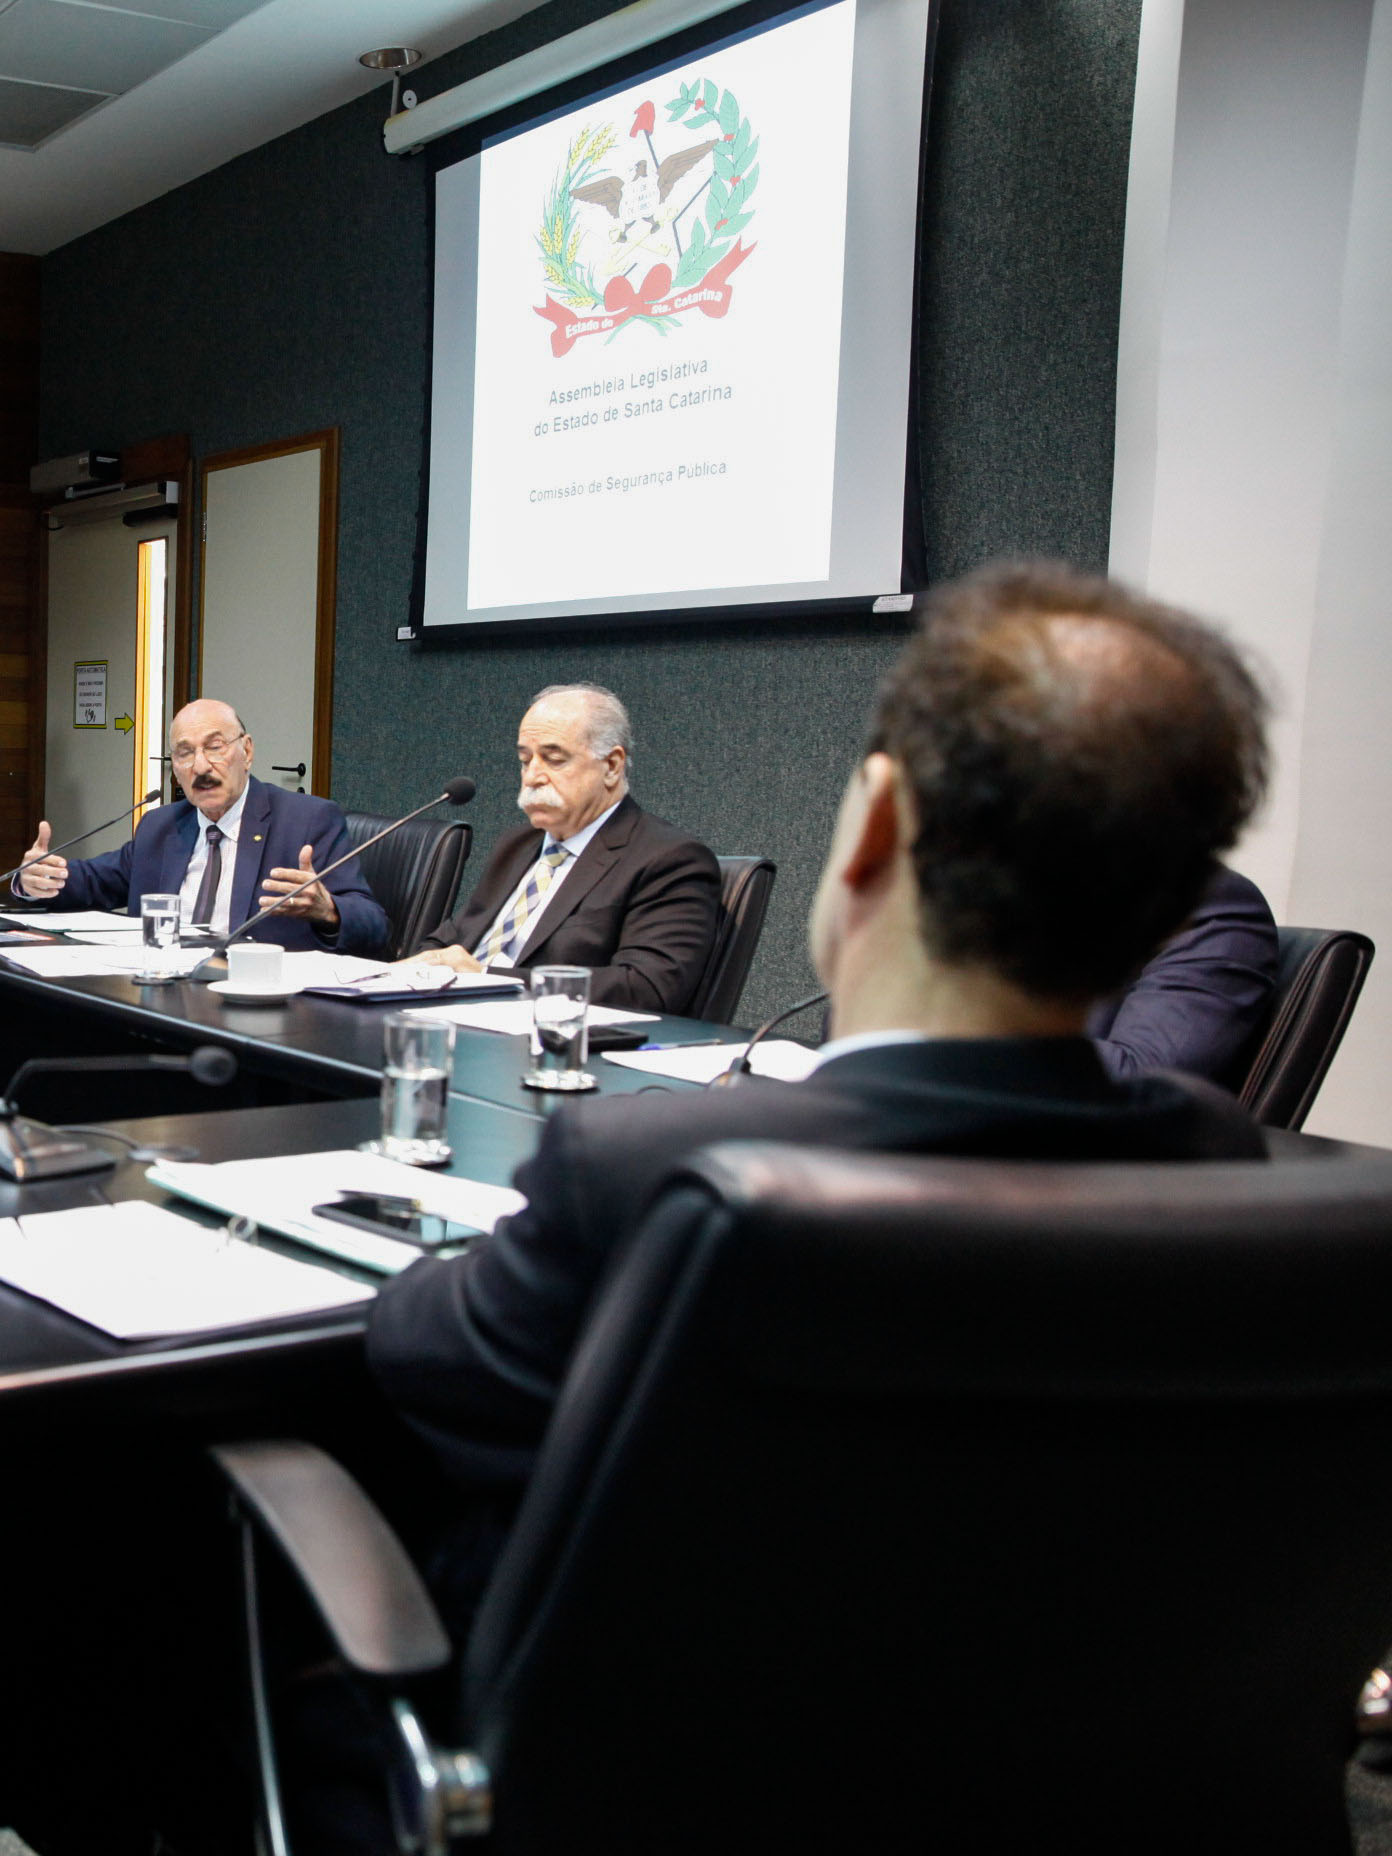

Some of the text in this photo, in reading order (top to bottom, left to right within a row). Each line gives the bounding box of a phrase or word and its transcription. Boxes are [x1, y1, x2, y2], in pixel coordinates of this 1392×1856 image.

[674, 288, 723, 309] Catarina
[565, 318, 599, 339] Estado
[549, 360, 708, 406] Assembleia Legislativa
[534, 384, 733, 437] do Estado de Santa Catarina
[529, 482, 584, 503] Comissão
[588, 480, 602, 495] de
[606, 468, 673, 492] Segurança
